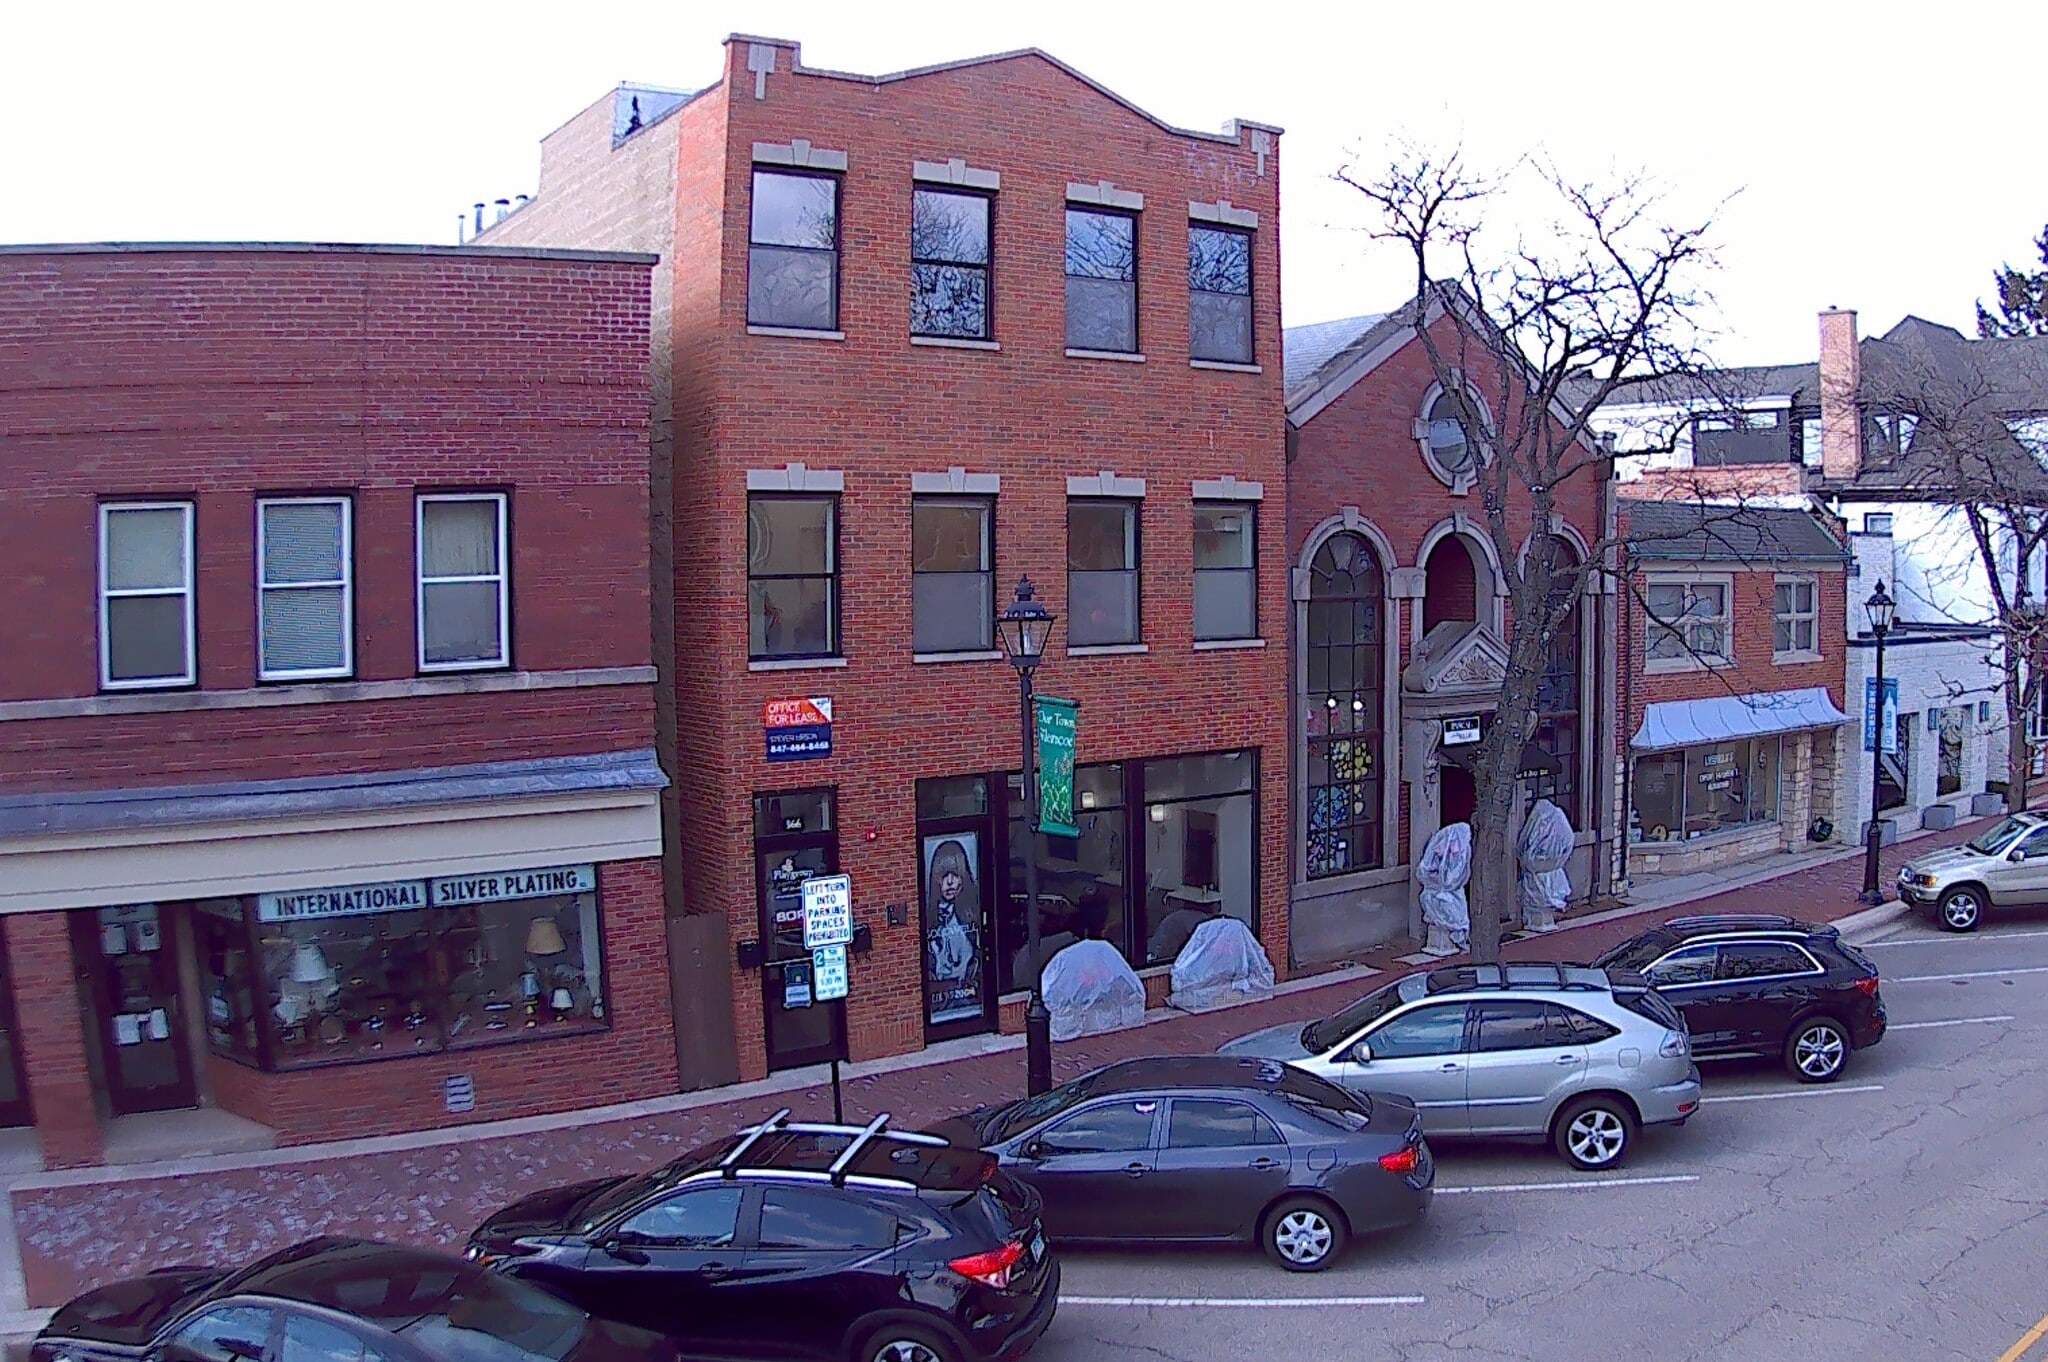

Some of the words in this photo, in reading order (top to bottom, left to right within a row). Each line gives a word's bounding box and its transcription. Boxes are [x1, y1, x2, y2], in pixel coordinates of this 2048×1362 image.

[769, 714, 787, 725] FOR
[789, 712, 818, 724] LEASE
[1037, 710, 1053, 725] Our
[1054, 713, 1075, 728] Town
[276, 884, 421, 917] INTERNATIONAL
[440, 879, 500, 902] SILVER
[503, 870, 577, 895] PLATING
[806, 885, 823, 896] LEFT
[824, 881, 846, 892] TURN
[816, 895, 837, 905] INTO
[808, 905, 846, 918] PARKING
[811, 917, 845, 930] SPACES
[808, 928, 849, 942] PROHIBITED
